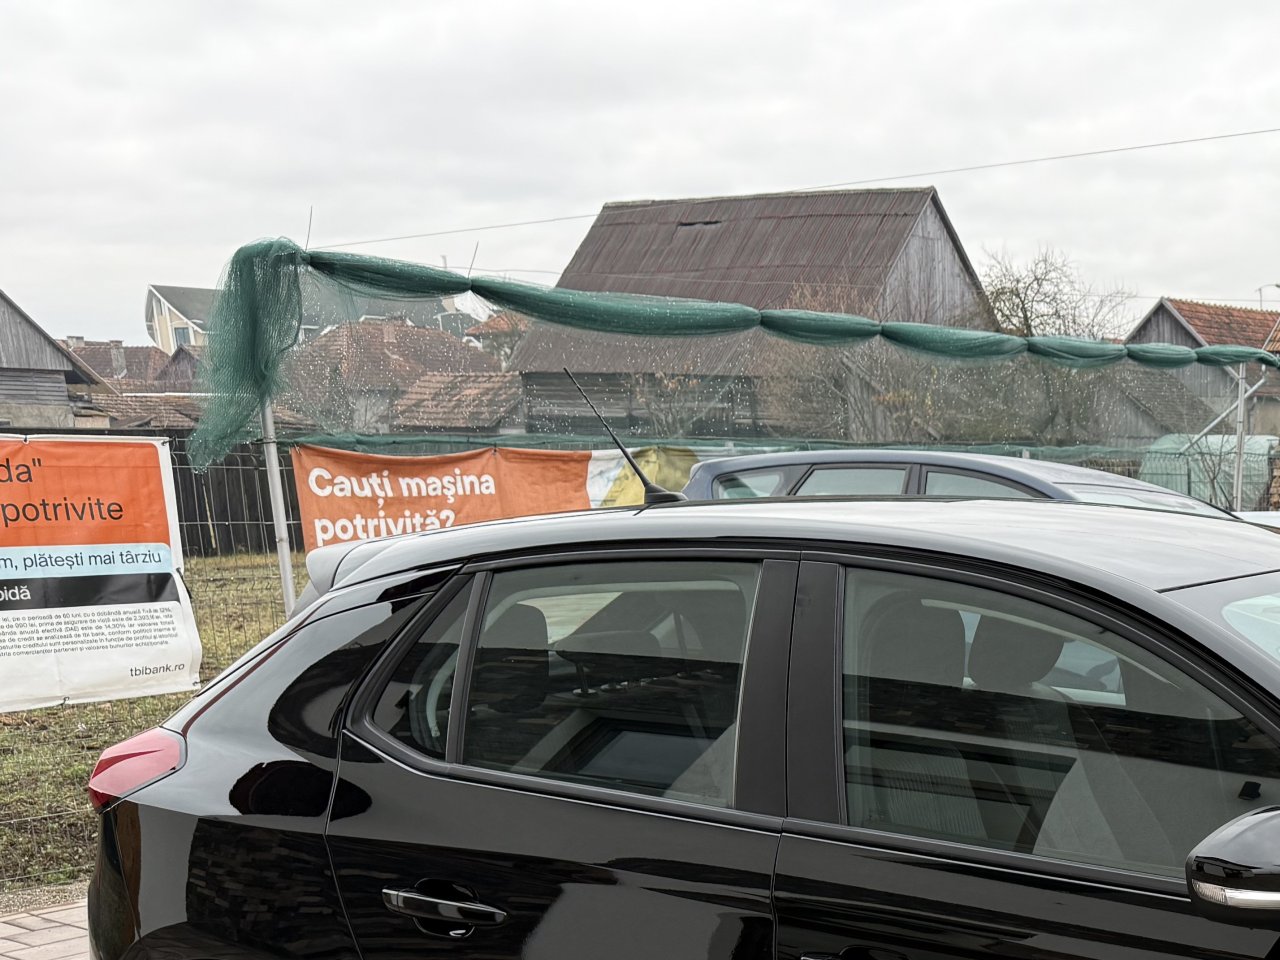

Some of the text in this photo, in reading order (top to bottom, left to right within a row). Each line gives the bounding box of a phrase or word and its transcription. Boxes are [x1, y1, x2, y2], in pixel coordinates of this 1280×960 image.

[308, 468, 394, 508] Cauți
[2, 497, 124, 528] potrivite
[23, 552, 84, 571] plătești
[89, 549, 116, 565] mai
[119, 549, 162, 564] târziu
[130, 663, 185, 677] tbibank.ro
